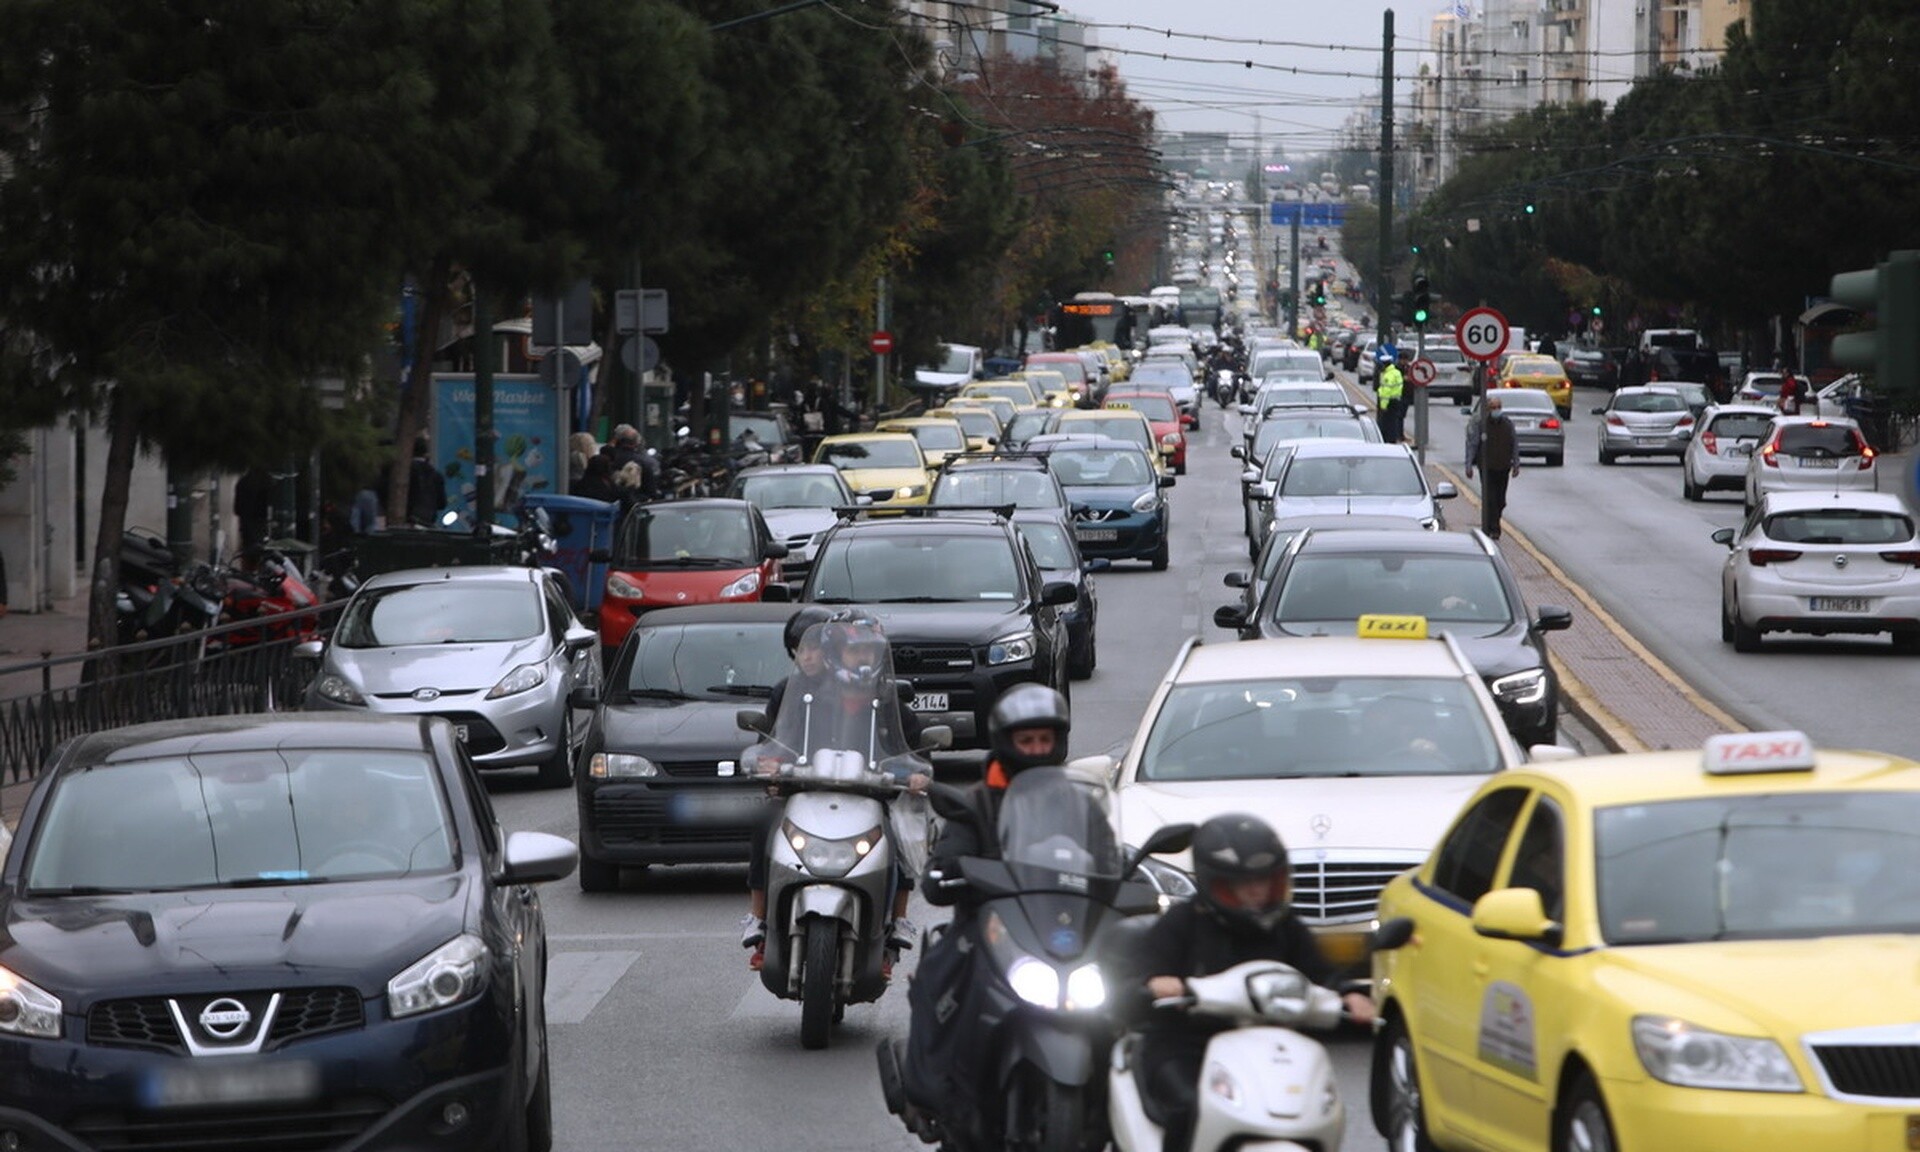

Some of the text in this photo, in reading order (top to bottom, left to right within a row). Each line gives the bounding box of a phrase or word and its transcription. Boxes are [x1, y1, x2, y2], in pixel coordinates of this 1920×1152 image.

[1468, 324, 1498, 345] 60
[1364, 619, 1418, 631] Taxi
[1720, 741, 1804, 761] TAXI
